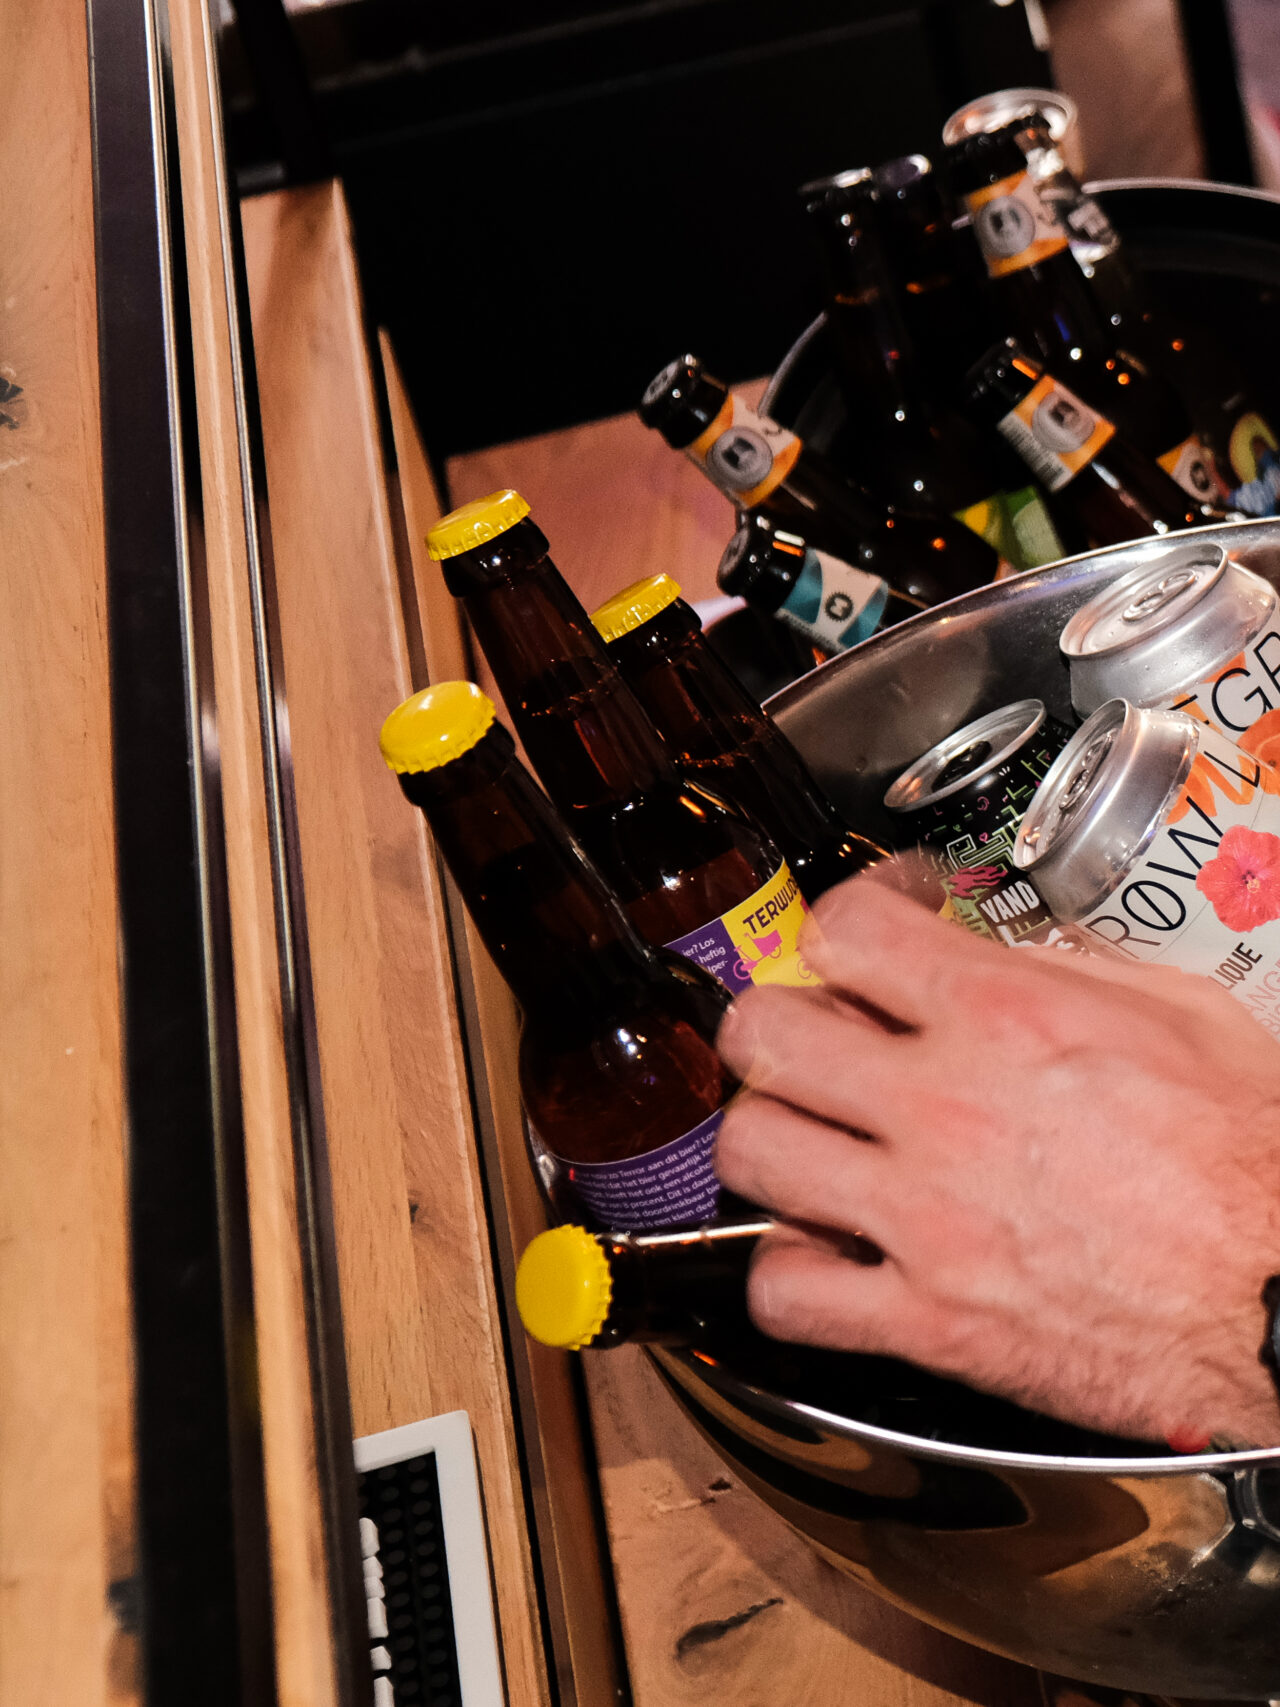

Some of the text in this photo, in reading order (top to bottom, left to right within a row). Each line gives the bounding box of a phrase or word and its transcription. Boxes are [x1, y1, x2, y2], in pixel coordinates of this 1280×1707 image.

[979, 880, 1040, 923] VAND
[698, 937, 715, 950] Los
[698, 946, 726, 964] heftig
[1207, 942, 1263, 990] LIQUE
[680, 1141, 700, 1157] bier?
[667, 1189, 682, 1200] Dit
